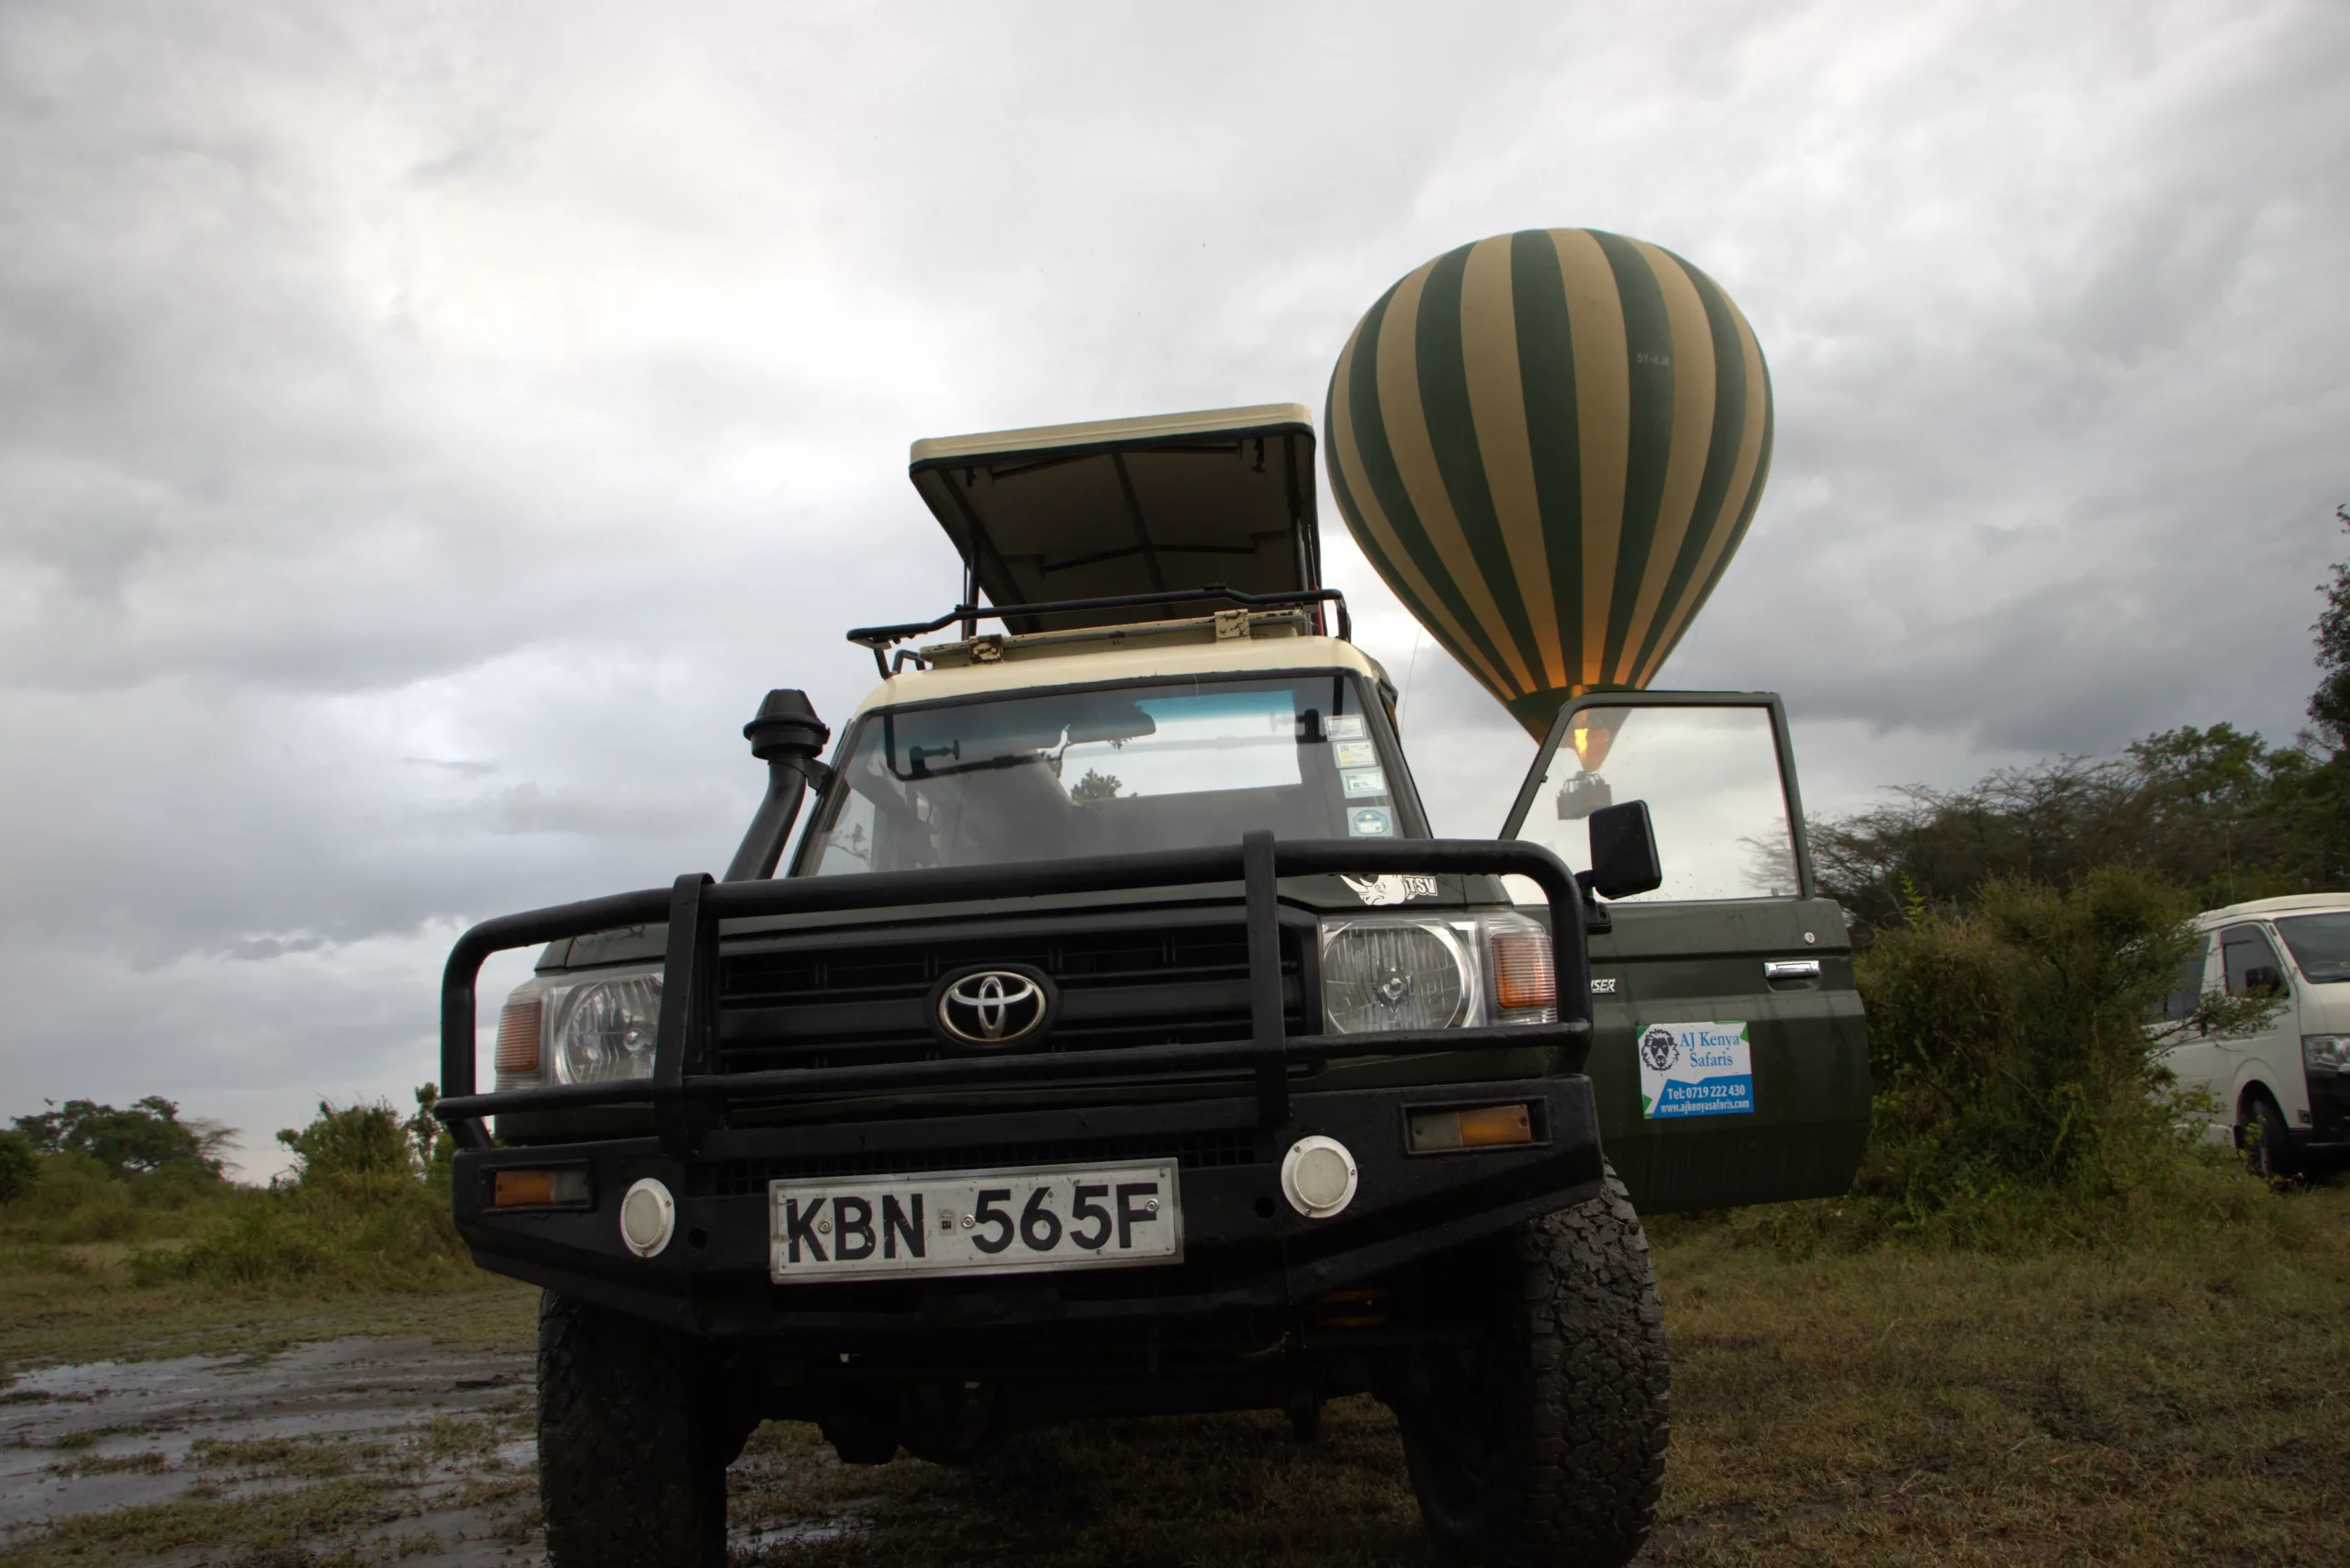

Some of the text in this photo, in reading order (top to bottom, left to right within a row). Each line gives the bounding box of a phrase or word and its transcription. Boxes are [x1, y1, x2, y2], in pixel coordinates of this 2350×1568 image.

[1404, 877, 1438, 896] TSV
[1591, 979, 1617, 993] ISER
[1680, 1031, 1740, 1051] AJ Kenya
[1690, 1051, 1733, 1068] Safaris
[1667, 1083, 1746, 1100] Tel: 0719 222 430
[1661, 1099, 1750, 1114] www.ajkenyasafaris.com
[786, 1182, 1159, 1263] KBN 565F
